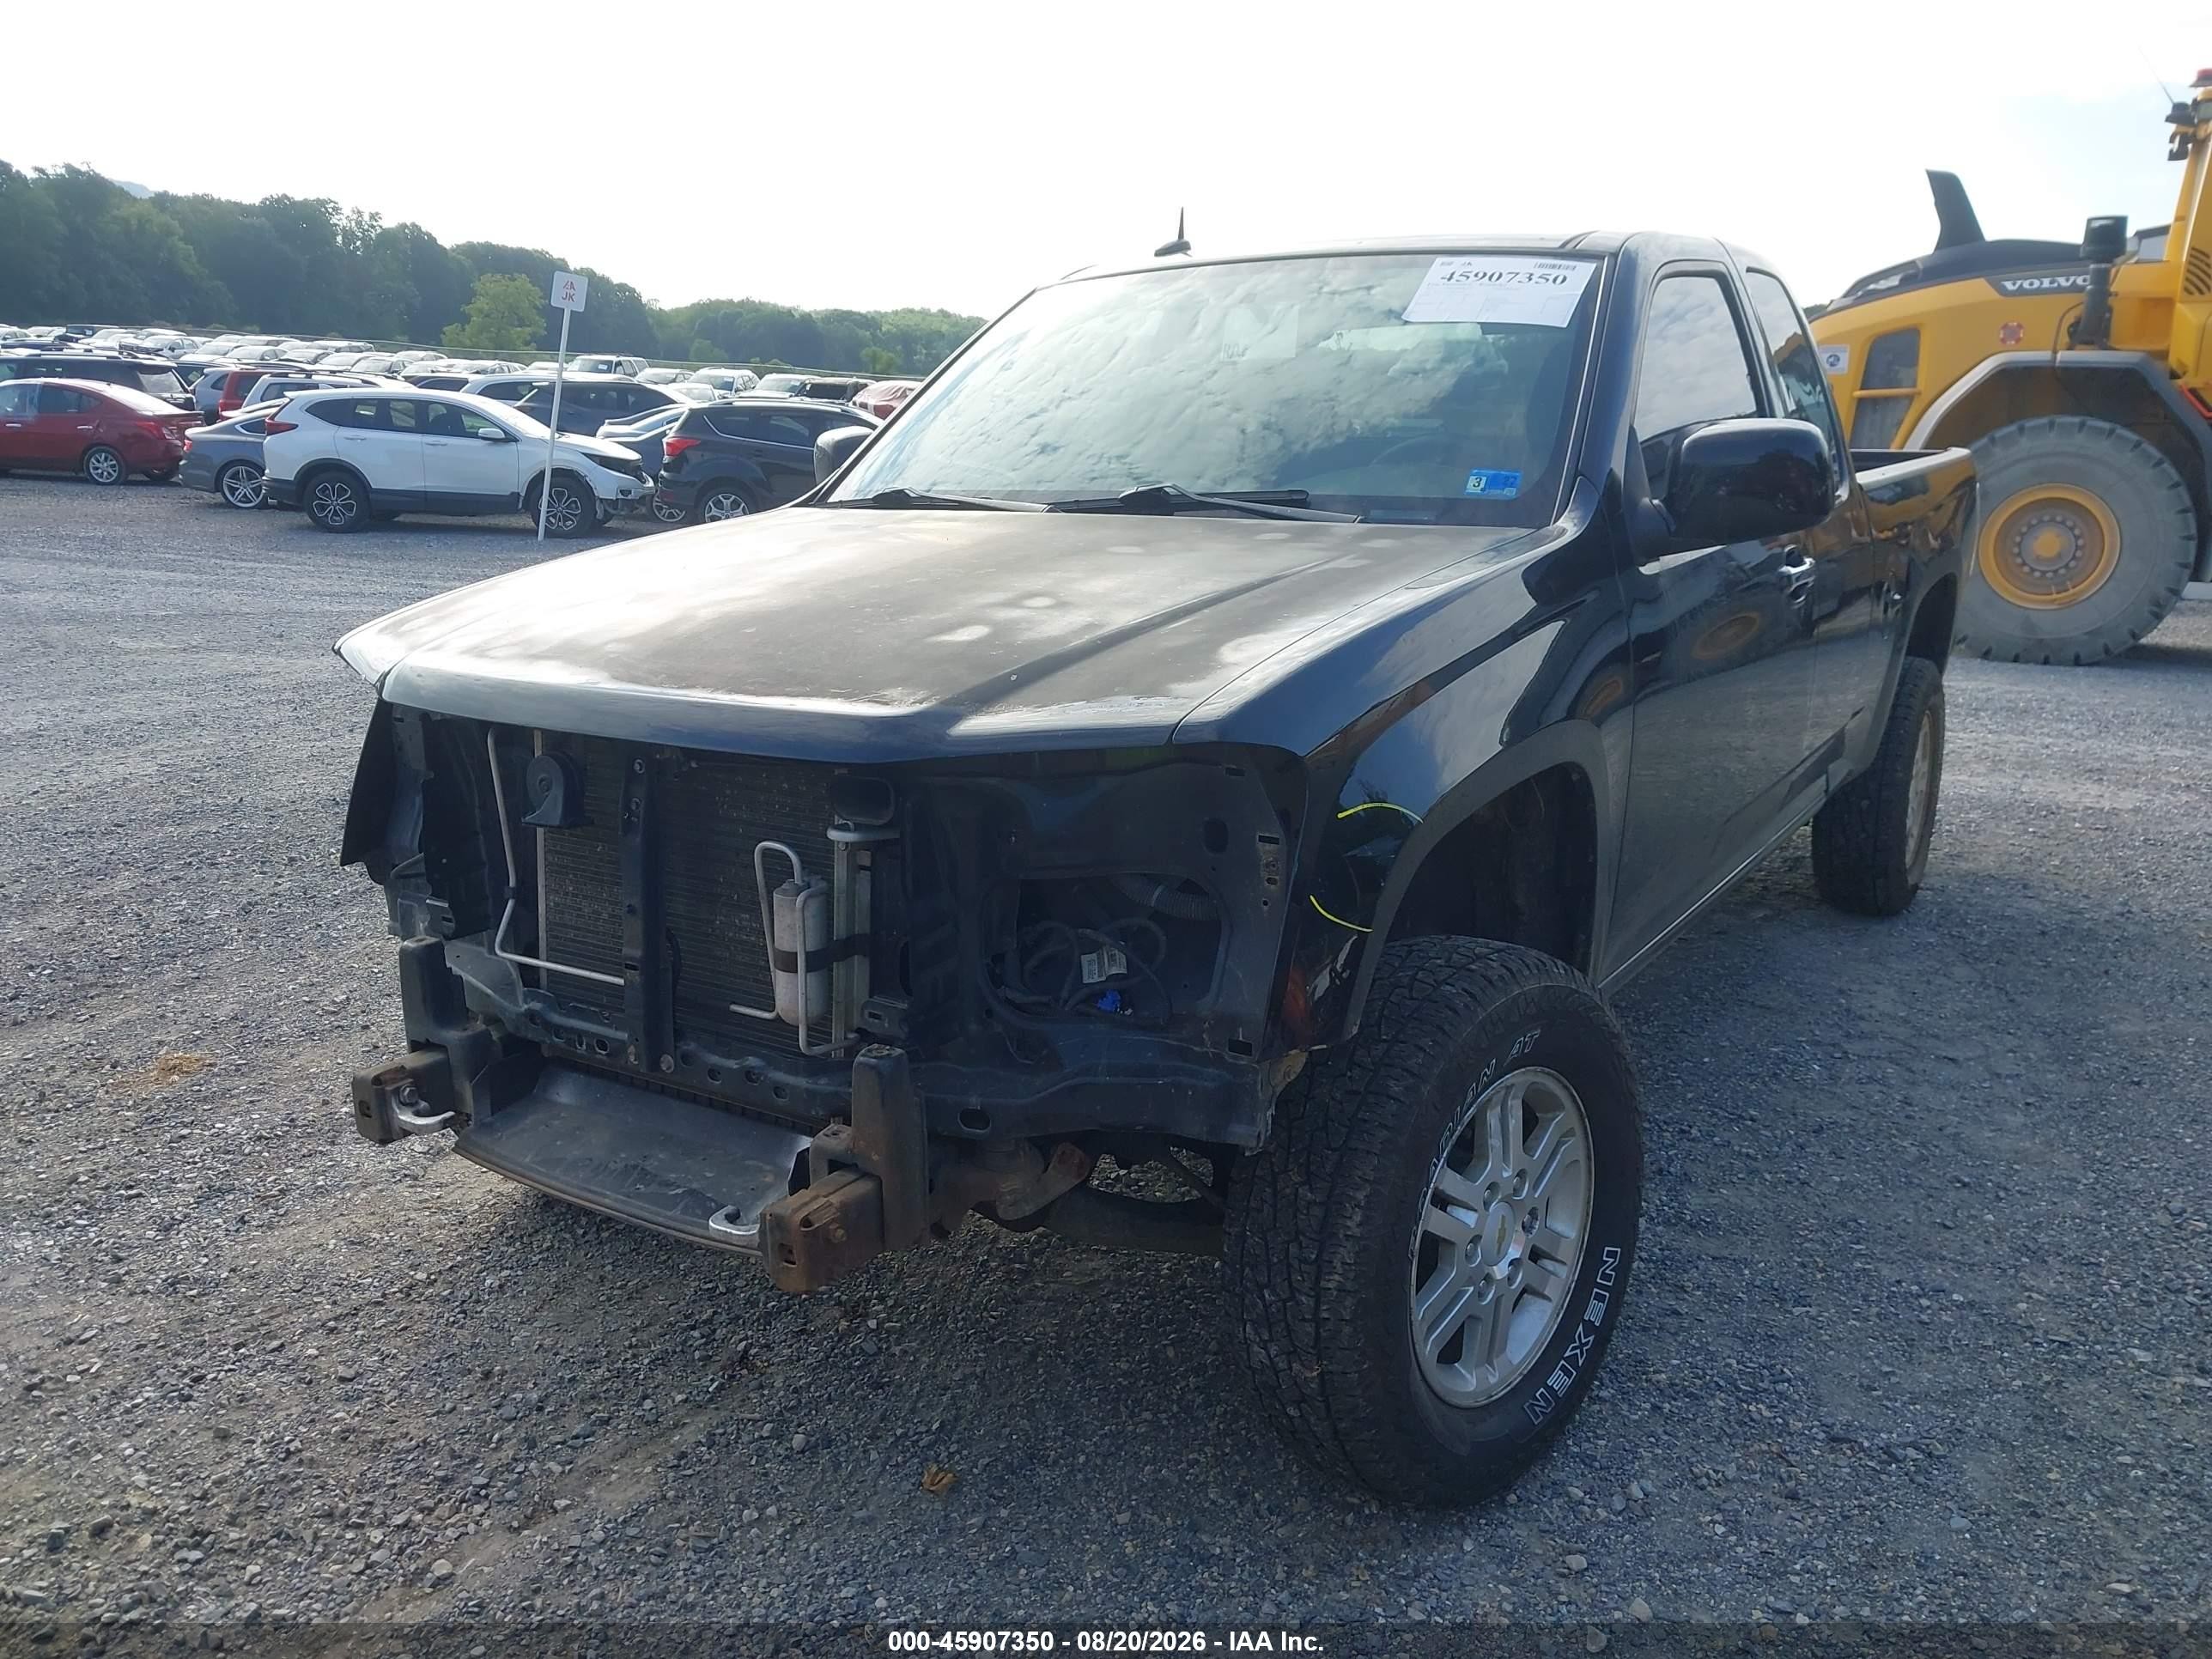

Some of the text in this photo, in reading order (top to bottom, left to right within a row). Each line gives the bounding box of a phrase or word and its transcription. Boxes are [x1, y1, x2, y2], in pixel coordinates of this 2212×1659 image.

[1440, 270, 1568, 286] 45907350
[561, 291, 575, 302] JK
[1473, 477, 1483, 488] 3
[1503, 1029, 1541, 1066] AT
[1523, 1246, 1621, 1425] NEXEN
